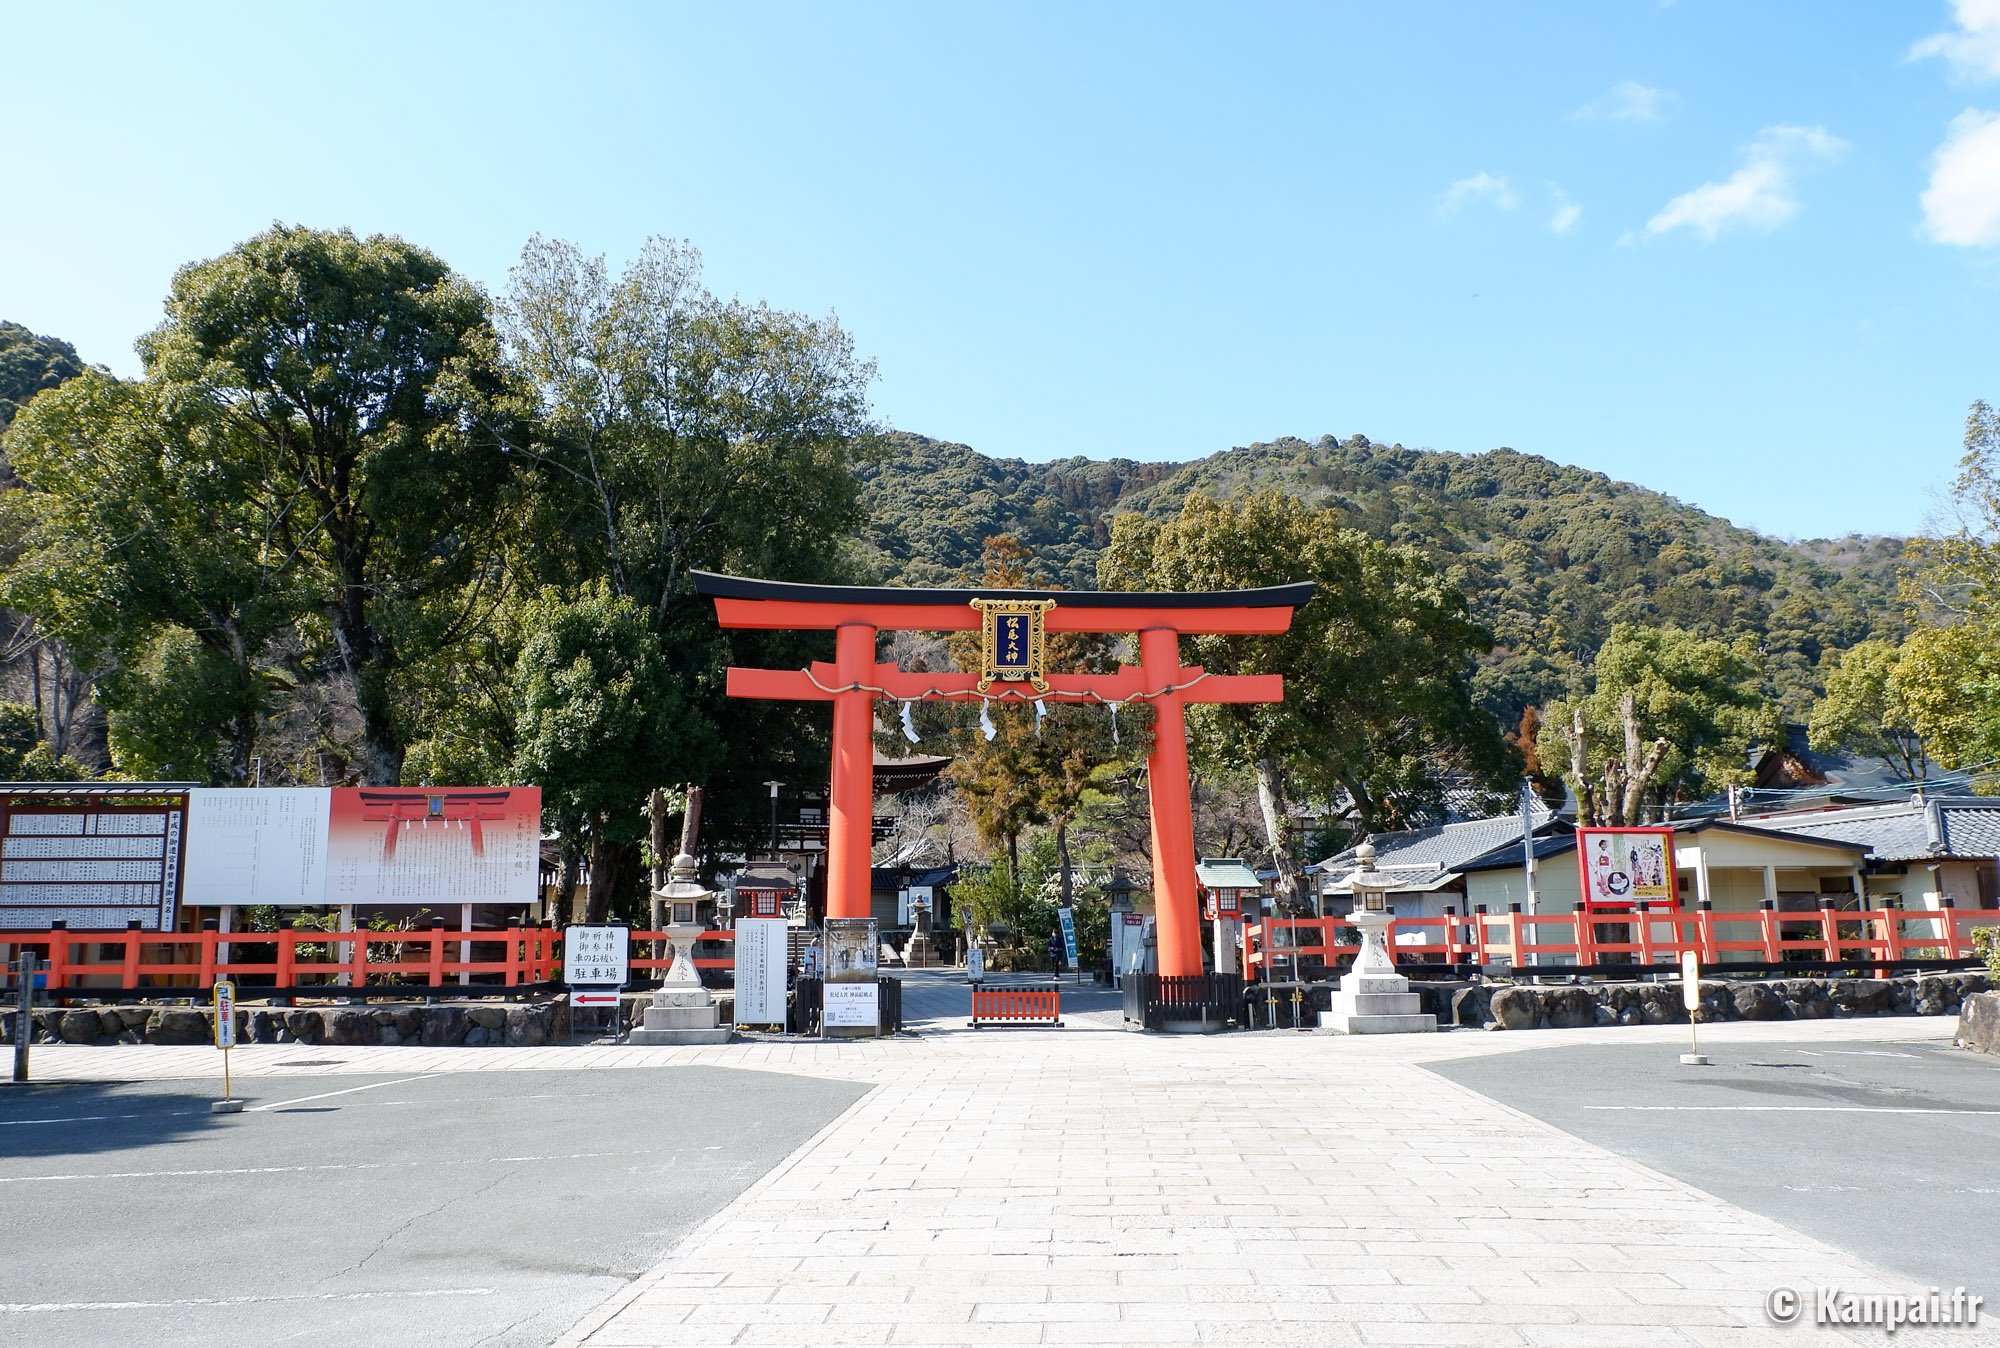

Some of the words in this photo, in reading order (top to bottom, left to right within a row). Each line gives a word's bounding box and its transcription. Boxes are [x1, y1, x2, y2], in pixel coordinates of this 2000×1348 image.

[579, 930, 615, 941] 御祈祷
[579, 942, 615, 952] 御参拝
[574, 953, 618, 964] 車のお祓い
[573, 967, 619, 981] 駐車場
